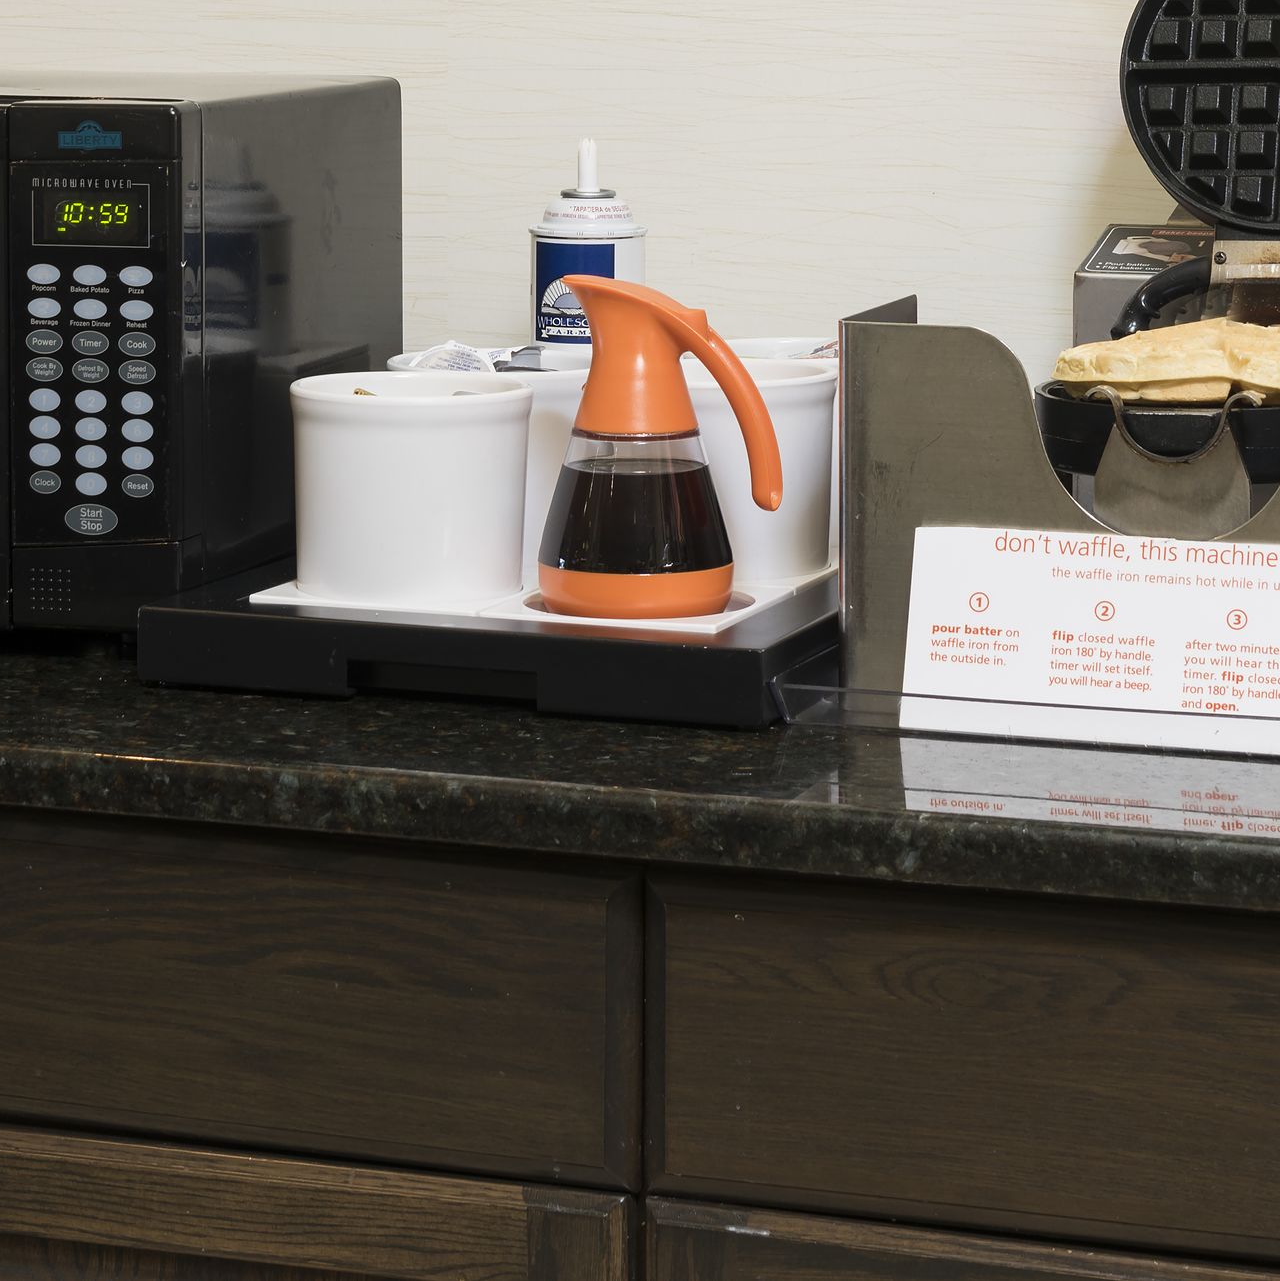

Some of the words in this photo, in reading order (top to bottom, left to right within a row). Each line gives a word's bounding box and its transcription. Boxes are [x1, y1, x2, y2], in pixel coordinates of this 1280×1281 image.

[63, 135, 118, 145] LIBERTY
[32, 178, 99, 188] MICROWAVE
[104, 179, 132, 189] OVEN
[63, 203, 129, 224] 10:59
[91, 286, 110, 294] Potato
[30, 318, 58, 326] Beverage
[91, 320, 111, 328] Dinner
[32, 338, 56, 346] Power
[80, 339, 101, 347] Timer
[127, 340, 147, 349] Cook
[128, 365, 147, 373] Speed
[34, 478, 56, 486] Clock
[127, 481, 148, 490] Reset
[80, 507, 103, 518] Start
[80, 520, 102, 531] Stop
[995, 531, 1051, 554] don't
[1059, 536, 1130, 562] waffle,
[1140, 540, 1178, 562] this
[1186, 544, 1278, 568] machine
[1052, 567, 1071, 578] the
[1075, 568, 1112, 582] waffle
[1117, 570, 1140, 582] iron
[1145, 573, 1191, 586] remains
[1196, 576, 1216, 588] hot
[1221, 577, 1253, 590] while
[1258, 579, 1269, 591] in
[932, 624, 961, 634] pour
[965, 624, 1003, 636] batter
[1052, 630, 1074, 644] flip
[1078, 633, 1114, 644] closed
[1118, 634, 1156, 647] waffle
[931, 638, 965, 649] waffle
[968, 639, 989, 650] iron
[993, 640, 1019, 652] from
[1185, 639, 1212, 650] after
[1215, 642, 1237, 653] two
[930, 651, 948, 662] the
[950, 654, 990, 665] outside
[993, 655, 1006, 666] in.
[1051, 645, 1072, 656] iron
[1099, 647, 1112, 662] by
[1115, 649, 1154, 662] handle.
[1050, 660, 1079, 671] timer
[1082, 661, 1101, 673] will
[1104, 663, 1120, 674] set
[1124, 664, 1153, 676] itself.
[1184, 656, 1206, 667] you
[1210, 656, 1231, 667] will
[1236, 657, 1262, 669] hear
[1183, 669, 1217, 681] timer.
[1221, 671, 1244, 684] flip
[1049, 676, 1068, 687] you
[1070, 675, 1088, 687] will
[1090, 677, 1112, 688] hear
[1115, 680, 1121, 689] a
[1124, 679, 1152, 693] beep.
[1182, 683, 1204, 694] iron
[1232, 686, 1244, 698] by
[1181, 699, 1202, 709] and
[1205, 702, 1239, 712] open.
